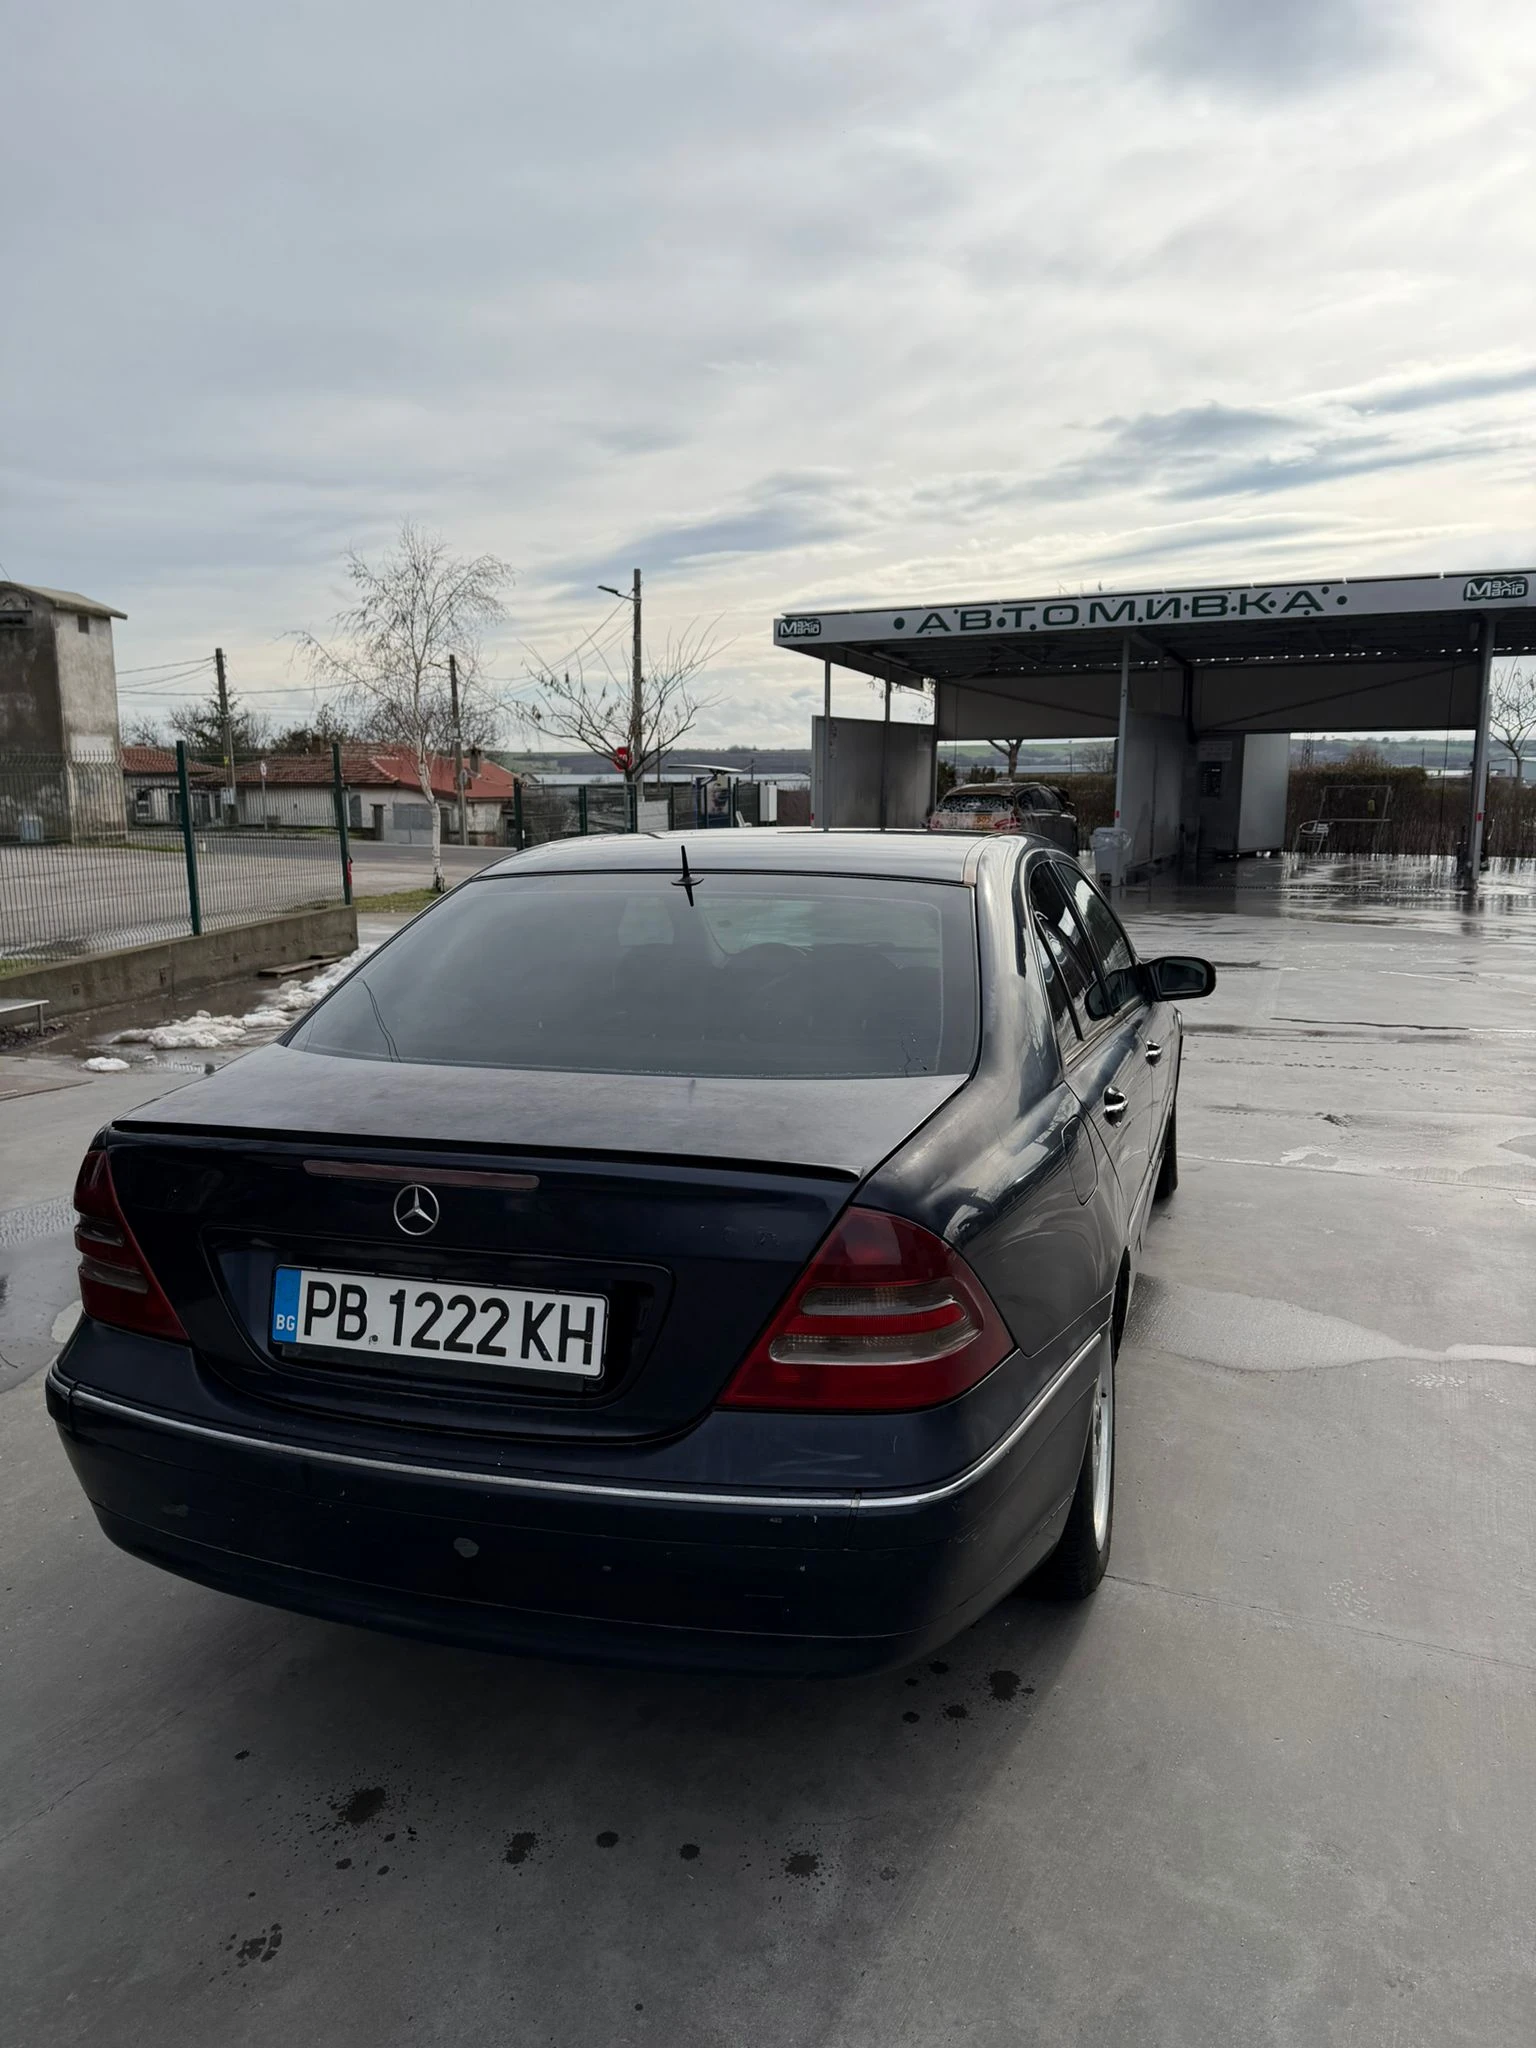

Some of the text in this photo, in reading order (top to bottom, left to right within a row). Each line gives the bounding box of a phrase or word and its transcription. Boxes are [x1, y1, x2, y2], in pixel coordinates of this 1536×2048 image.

[275, 1314, 296, 1332] BG
[388, 1288, 511, 1358] 1222
[519, 1300, 596, 1366] KH
